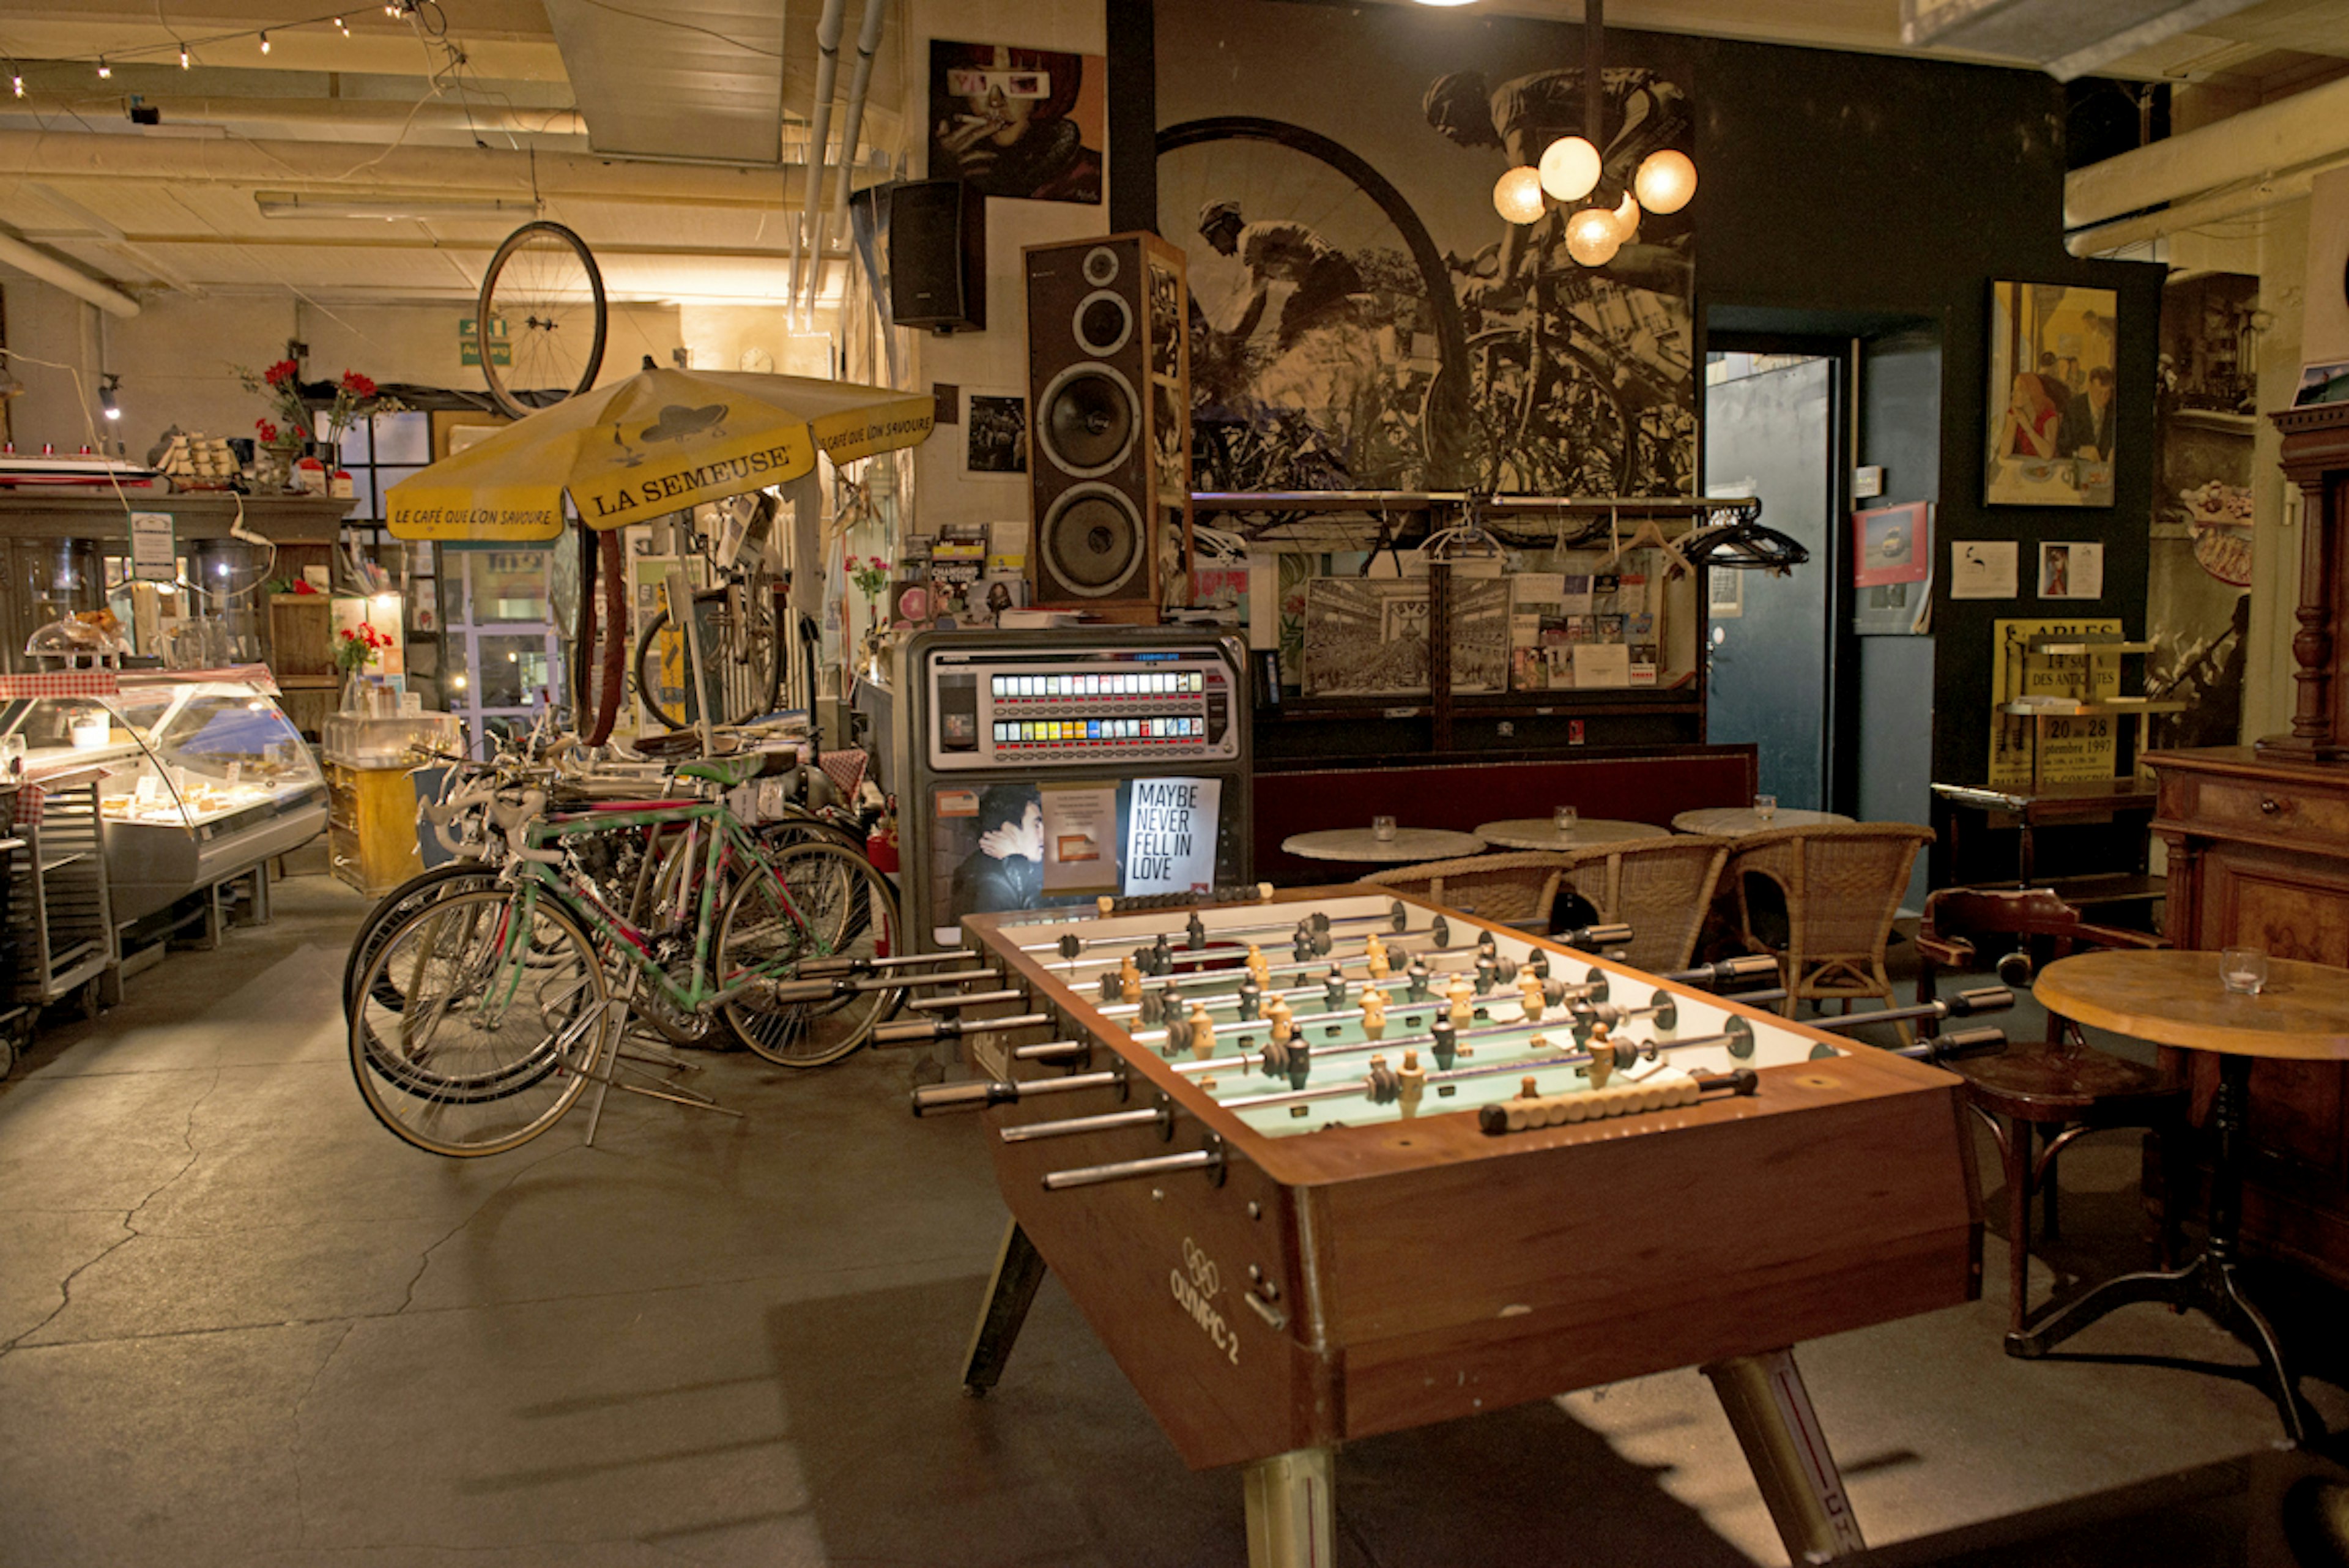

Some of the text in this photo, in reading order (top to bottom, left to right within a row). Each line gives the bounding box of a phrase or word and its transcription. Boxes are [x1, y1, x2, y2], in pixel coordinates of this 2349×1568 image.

[592, 445, 790, 517] LA SEMEUSE
[395, 510, 410, 523] LE
[413, 507, 443, 524] CAFÉ
[445, 510, 469, 523] QUE
[500, 510, 552, 525] SAVOURE
[2033, 673, 2053, 686] DES
[2050, 720, 2070, 738] 20
[2088, 719, 2107, 737] 28
[2087, 739, 2112, 753] 1997
[1138, 783, 1199, 809] MAYBE
[1135, 808, 1190, 833] NEVER
[1134, 831, 1192, 856] FELL IN
[1132, 856, 1173, 880] LOVE
[1228, 1330, 1239, 1366] 2
